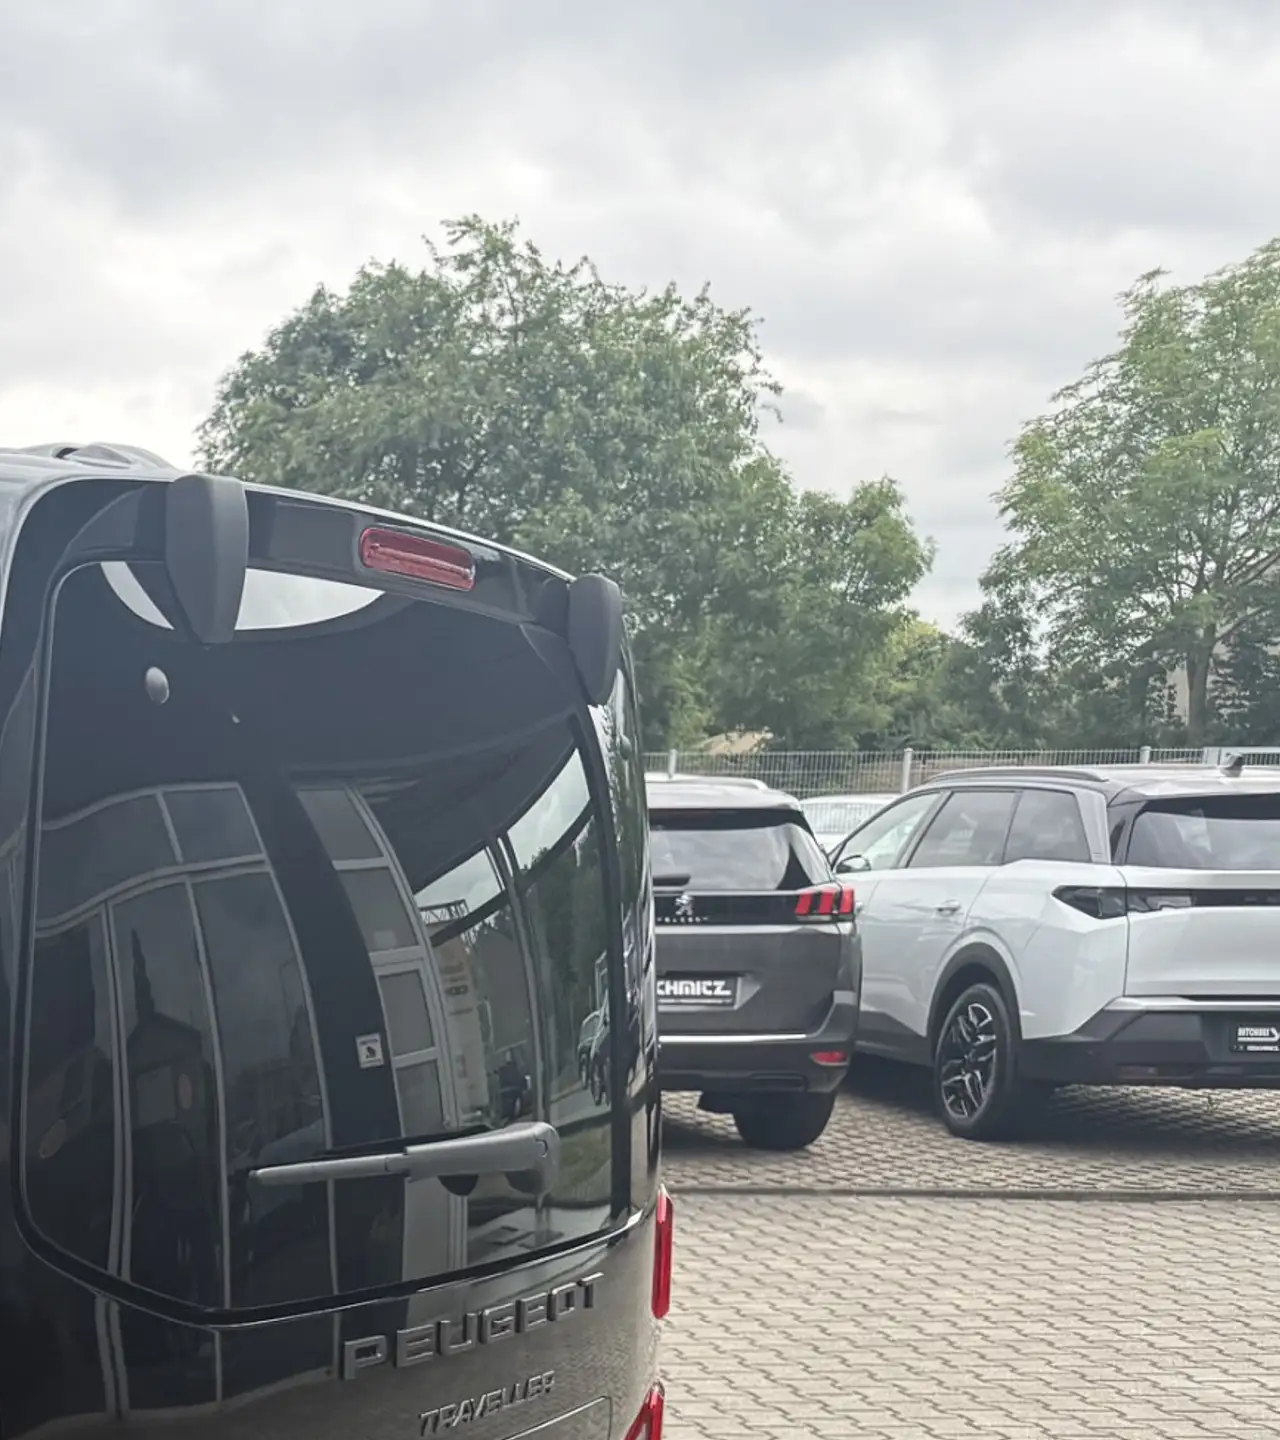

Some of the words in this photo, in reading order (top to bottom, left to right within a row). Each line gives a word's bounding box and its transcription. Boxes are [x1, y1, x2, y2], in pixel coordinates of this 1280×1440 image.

[656, 980, 732, 996] CHMITZ
[341, 1272, 604, 1381] PEUGEOT
[418, 1370, 556, 1436] TRAVELLER
